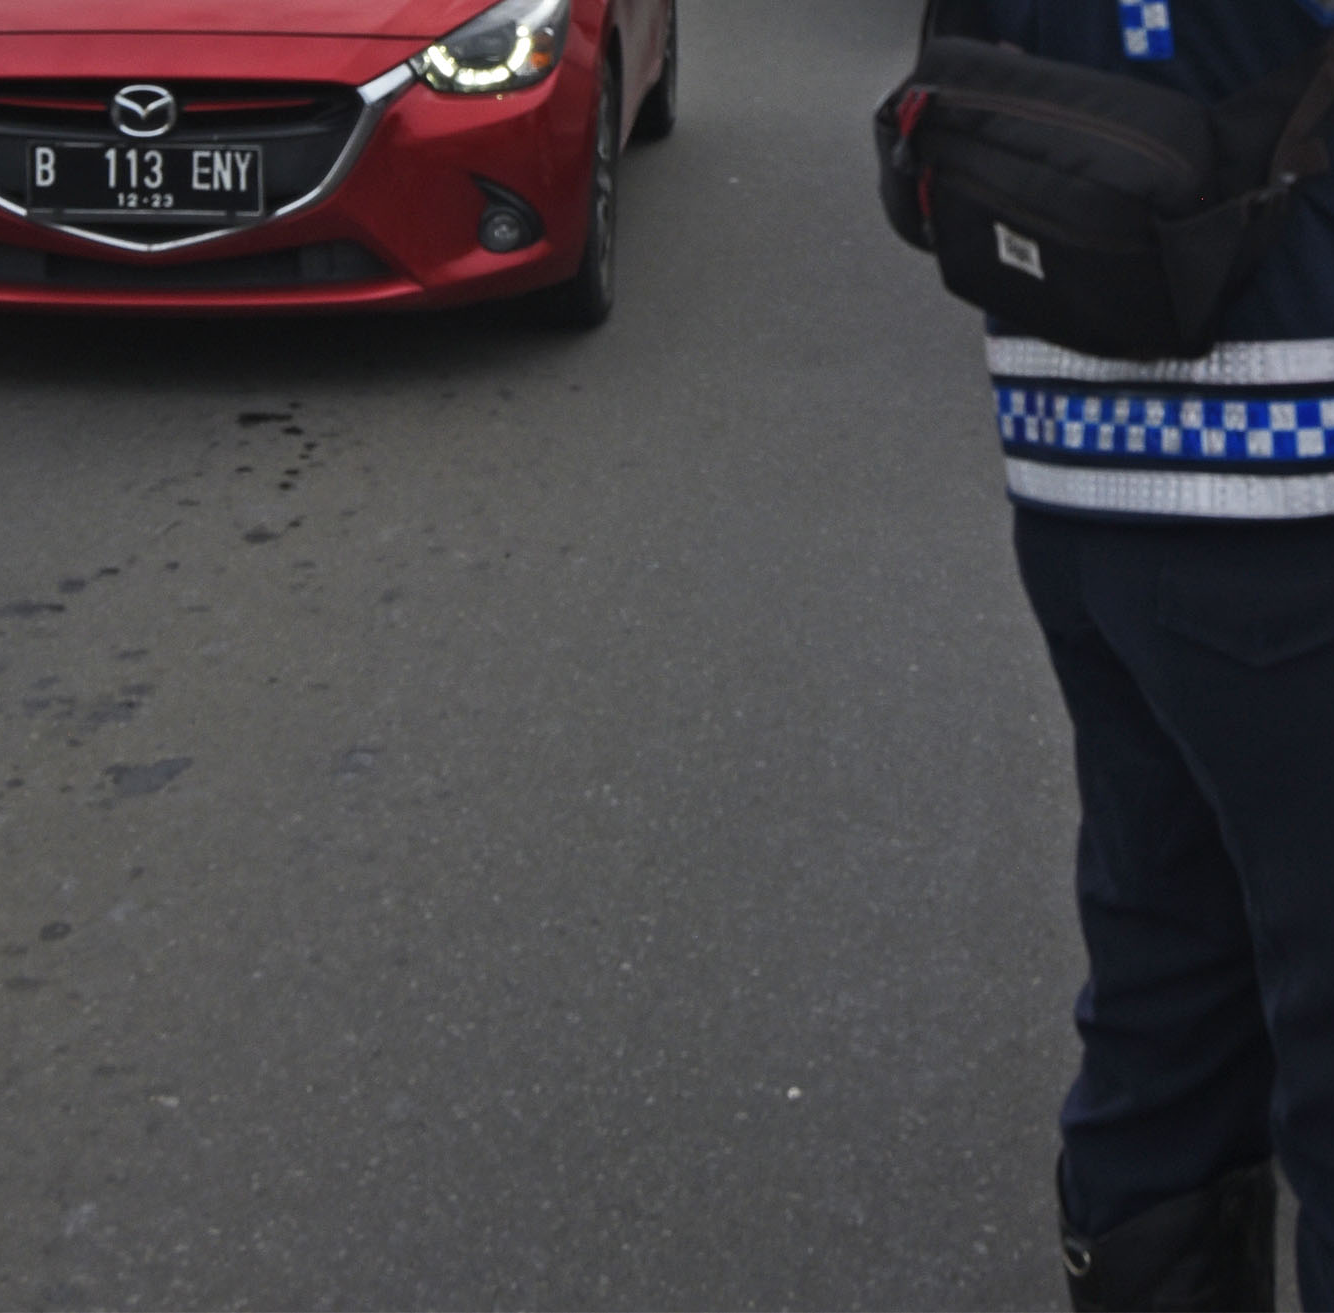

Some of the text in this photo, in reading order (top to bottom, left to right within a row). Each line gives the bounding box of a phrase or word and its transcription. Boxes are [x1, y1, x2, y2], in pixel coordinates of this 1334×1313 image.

[35, 147, 252, 192] B 113 ENY
